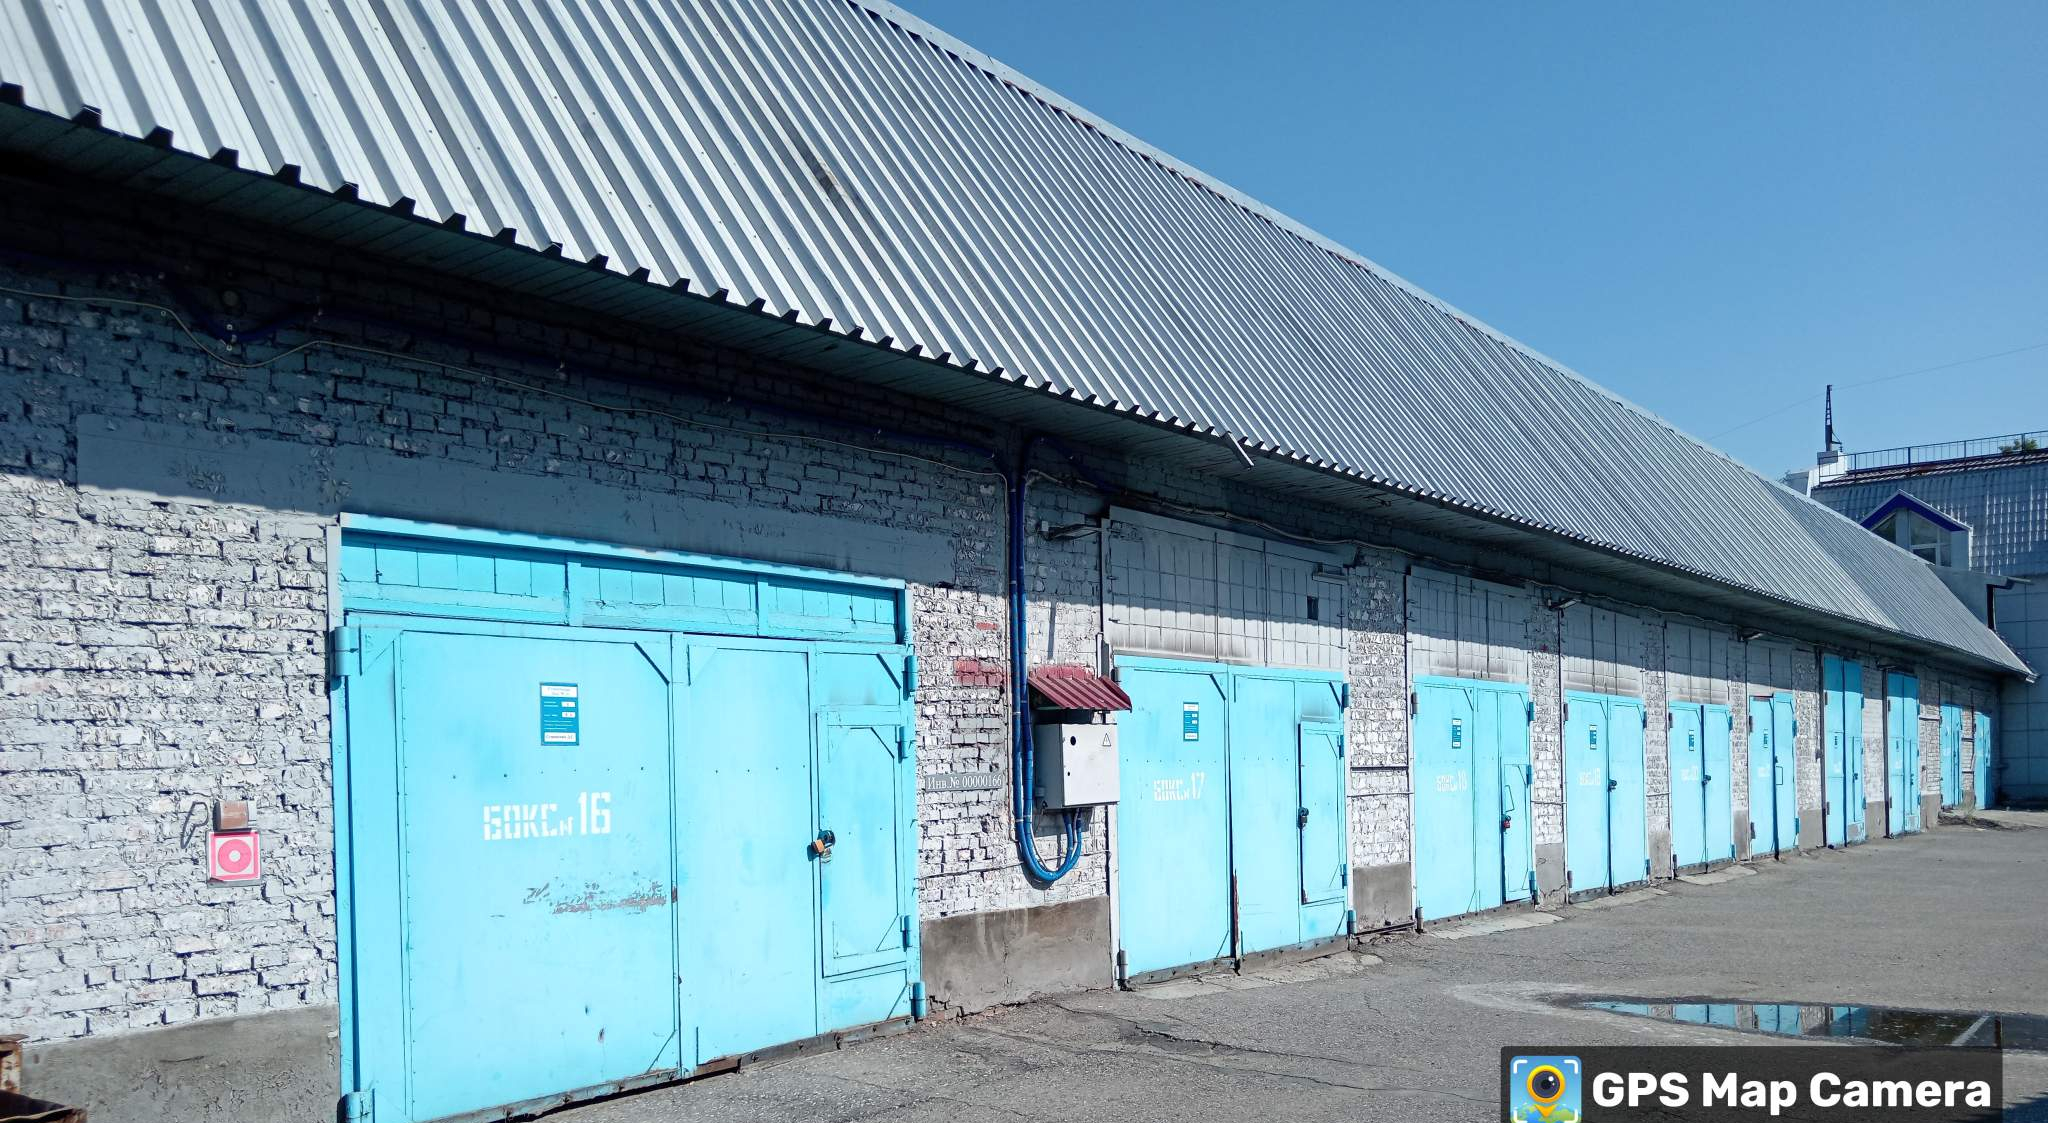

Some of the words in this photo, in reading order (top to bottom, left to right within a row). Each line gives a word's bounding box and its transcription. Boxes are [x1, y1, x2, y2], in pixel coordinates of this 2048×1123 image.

[962, 774, 1003, 789] 00000166
[483, 803, 558, 841] БОКС
[578, 791, 612, 835] 16
